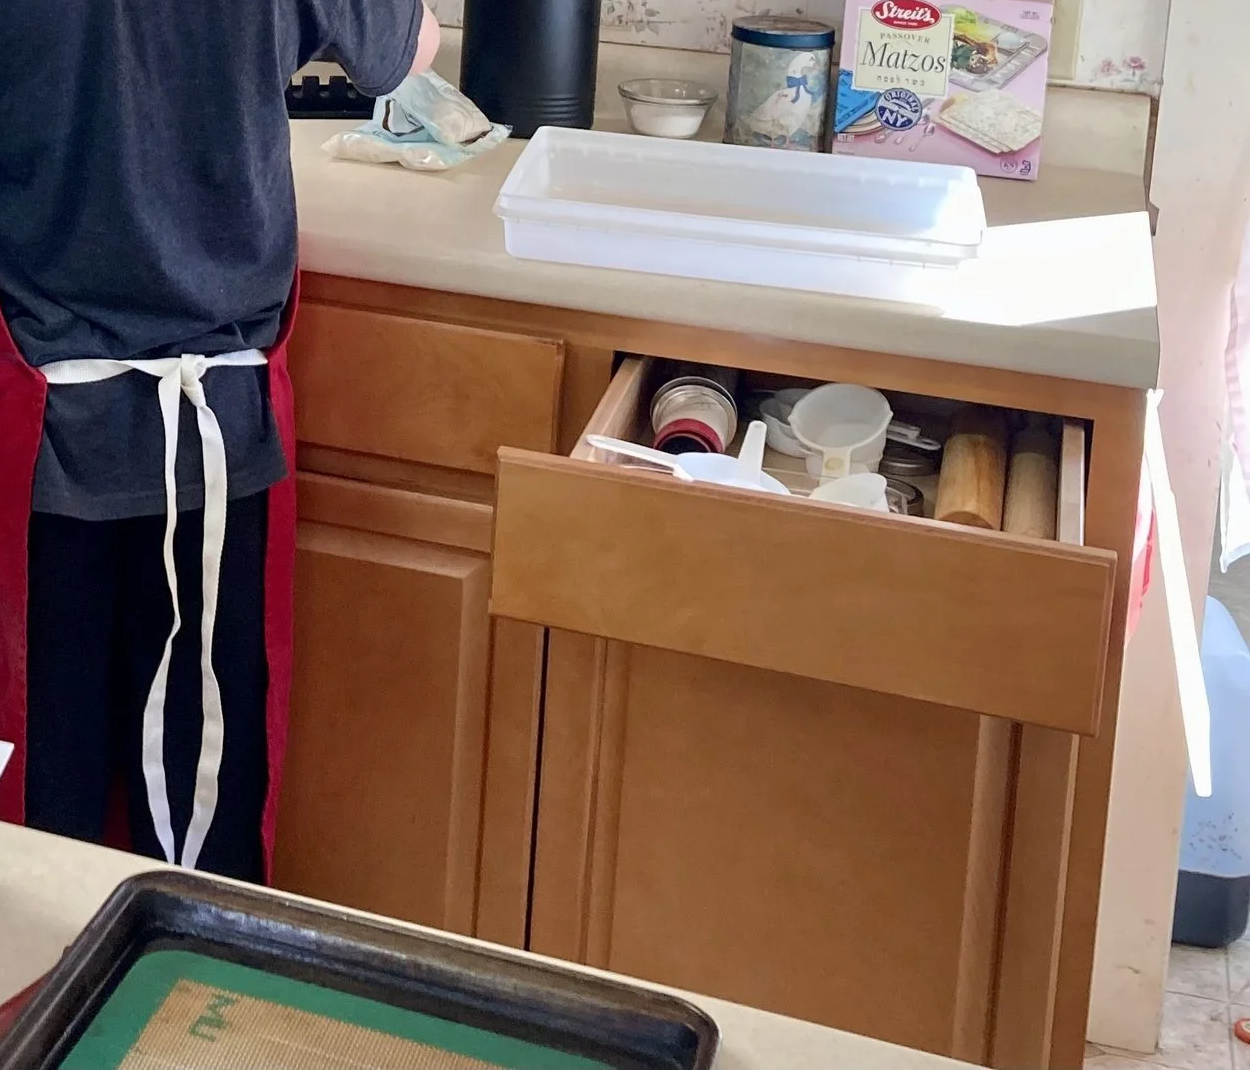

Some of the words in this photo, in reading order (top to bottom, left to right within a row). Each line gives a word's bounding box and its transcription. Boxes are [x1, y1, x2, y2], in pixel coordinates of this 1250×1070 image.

[875, 0, 936, 24] Streit's
[880, 32, 932, 45] PASSOVER
[859, 40, 947, 74] Matzos
[883, 89, 919, 114] ORIGINAL
[882, 108, 908, 128] NY
